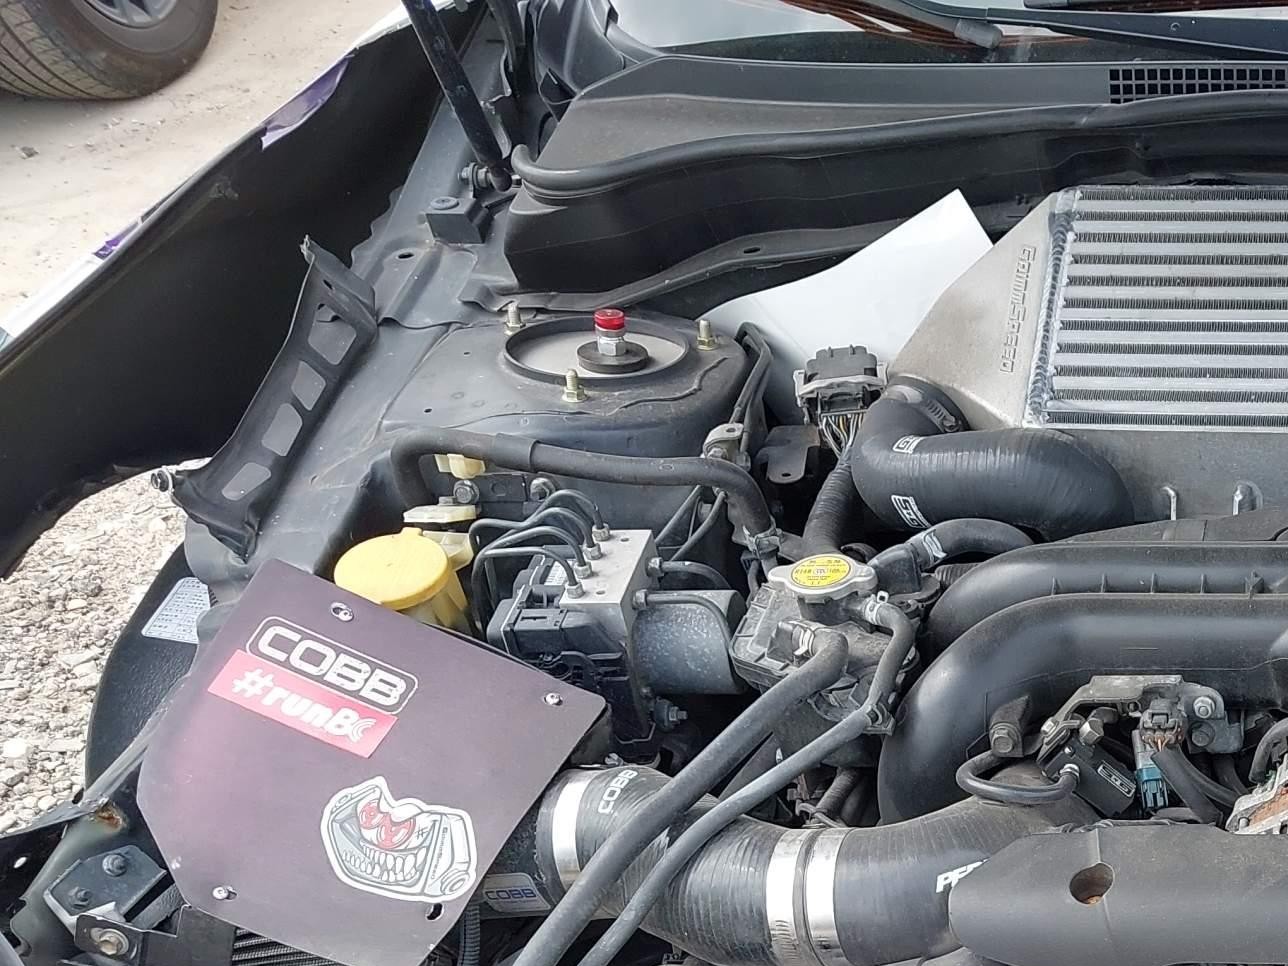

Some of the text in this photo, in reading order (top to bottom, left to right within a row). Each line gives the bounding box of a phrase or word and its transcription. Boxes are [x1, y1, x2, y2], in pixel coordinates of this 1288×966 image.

[257, 625, 407, 706] COBB
[597, 769, 639, 815] COBB
[484, 888, 537, 901] COBB
